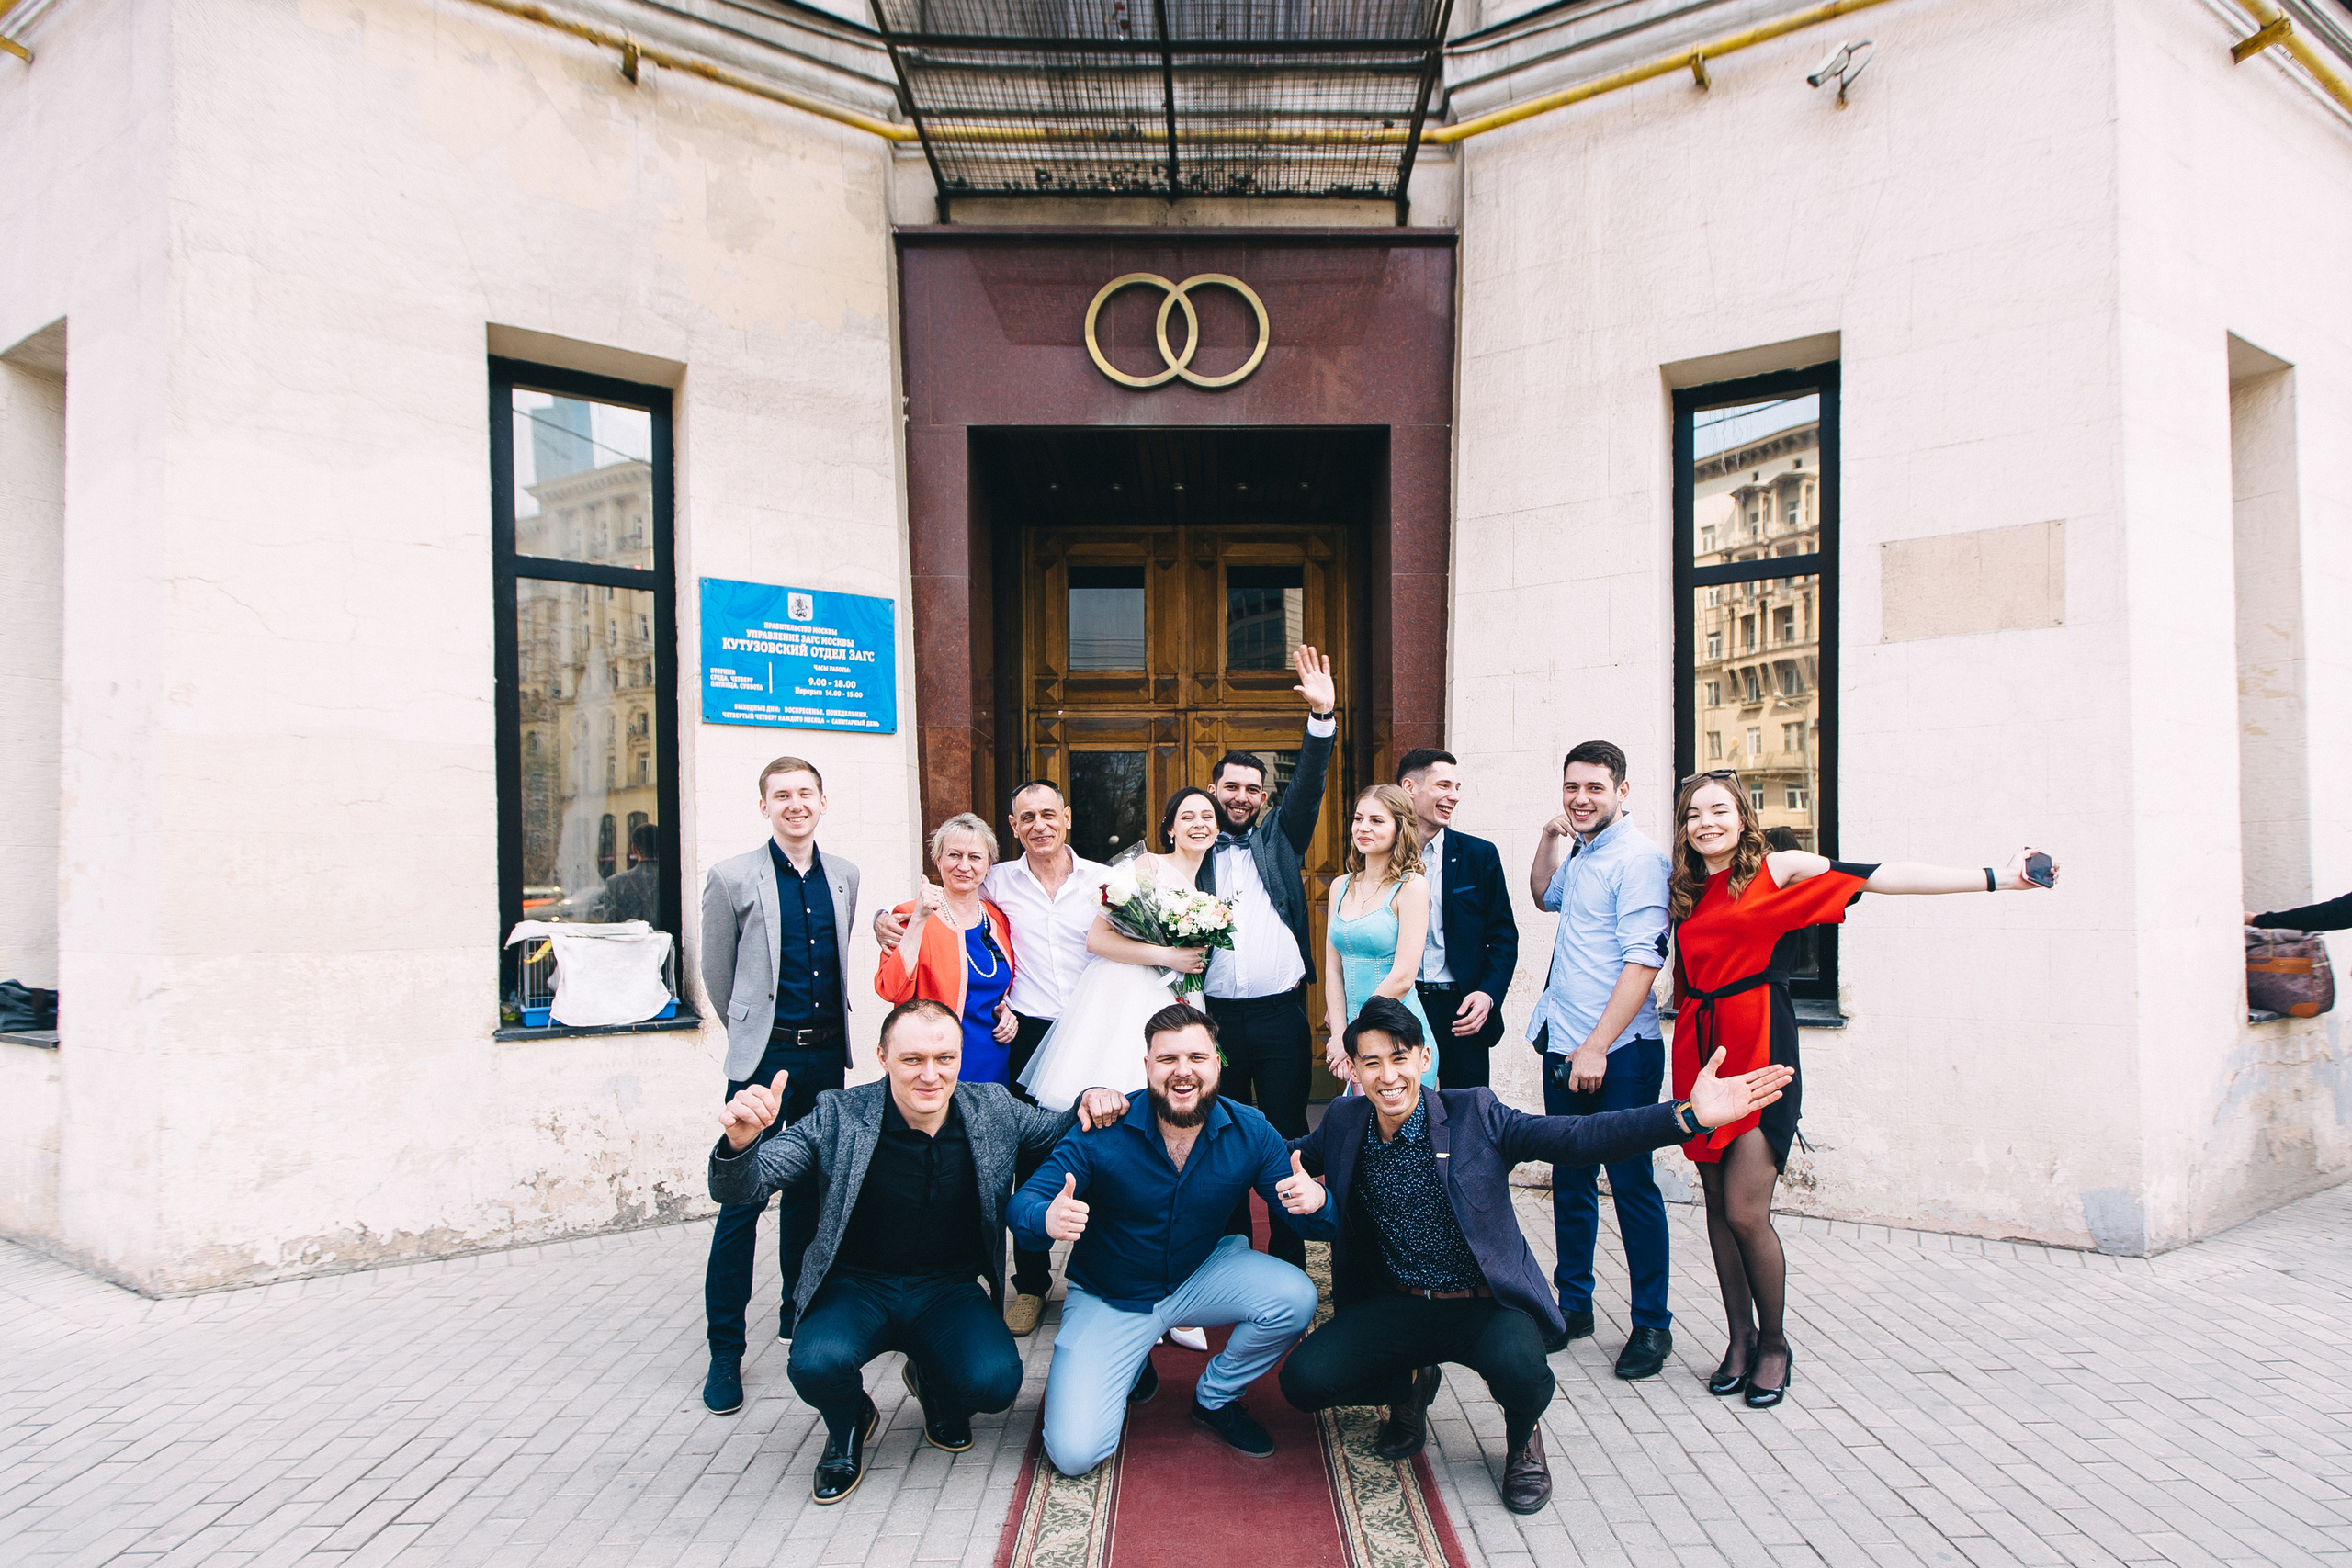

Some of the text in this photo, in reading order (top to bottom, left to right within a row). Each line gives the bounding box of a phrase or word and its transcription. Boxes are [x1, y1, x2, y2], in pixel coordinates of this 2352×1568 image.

[763, 622, 838, 636] ПРАВИТЕЛЬСТВО МОСКВЫ
[746, 629, 854, 649] УПРАВЛЕНИЕ ЗАГС МОСКВЫ
[722, 637, 875, 662] КУТУЗОВСКИЙ ОТДЕЛ ЗАГС
[808, 677, 827, 687] 9.00
[833, 679, 856, 689] 18.00
[795, 686, 823, 696] Перерыв
[825, 689, 842, 697] 14.00
[846, 691, 864, 699] 15.00
